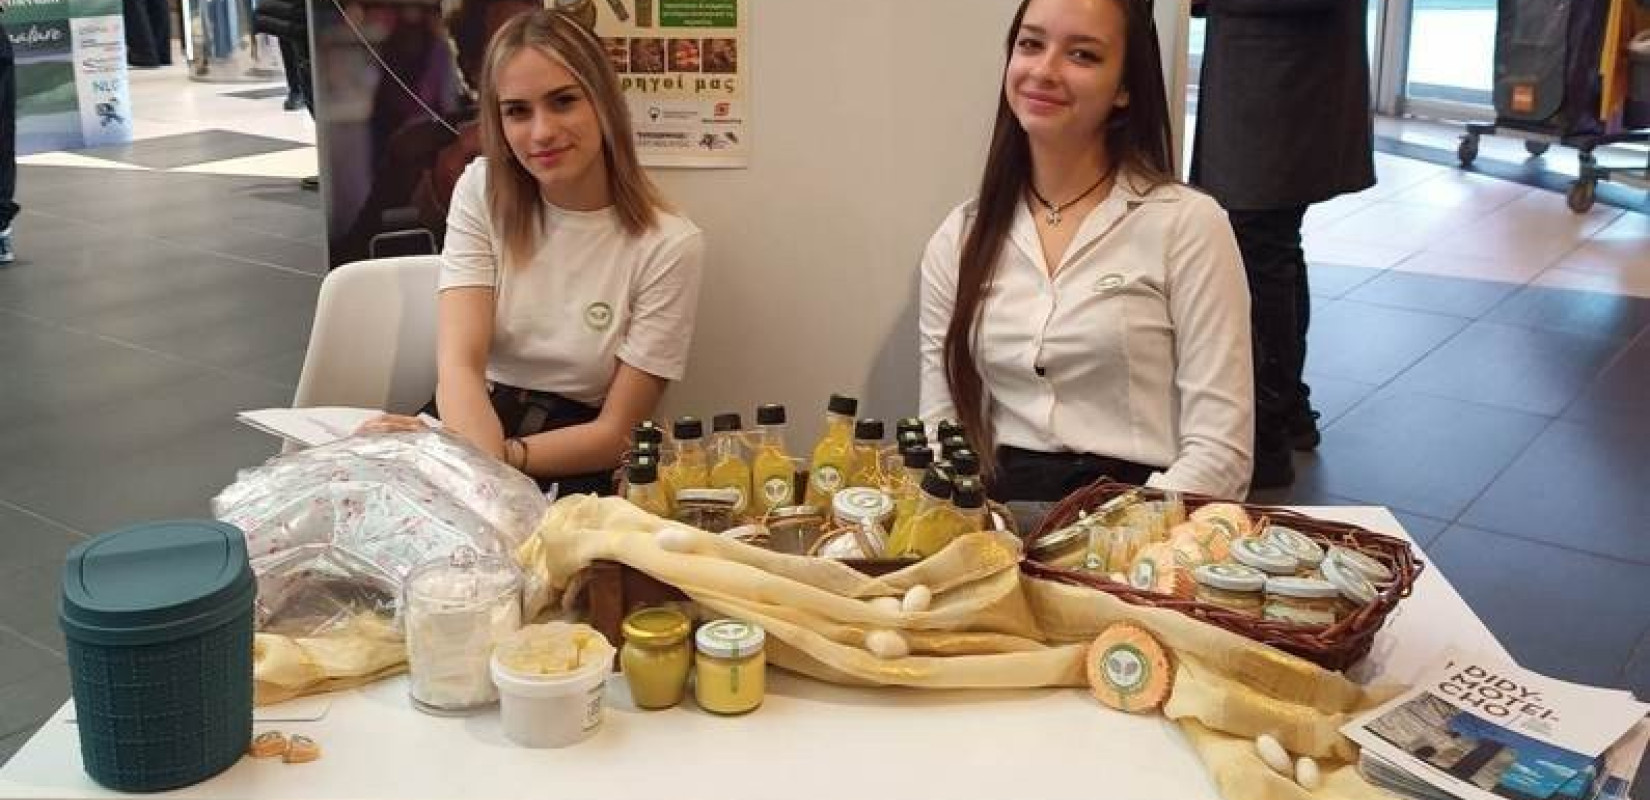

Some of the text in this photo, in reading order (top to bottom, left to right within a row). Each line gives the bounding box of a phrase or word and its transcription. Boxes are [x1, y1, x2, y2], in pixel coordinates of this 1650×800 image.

[621, 74, 735, 93] ρηγοί μας
[1438, 681, 1509, 716] CHO
[1464, 665, 1542, 701] DIDY-
